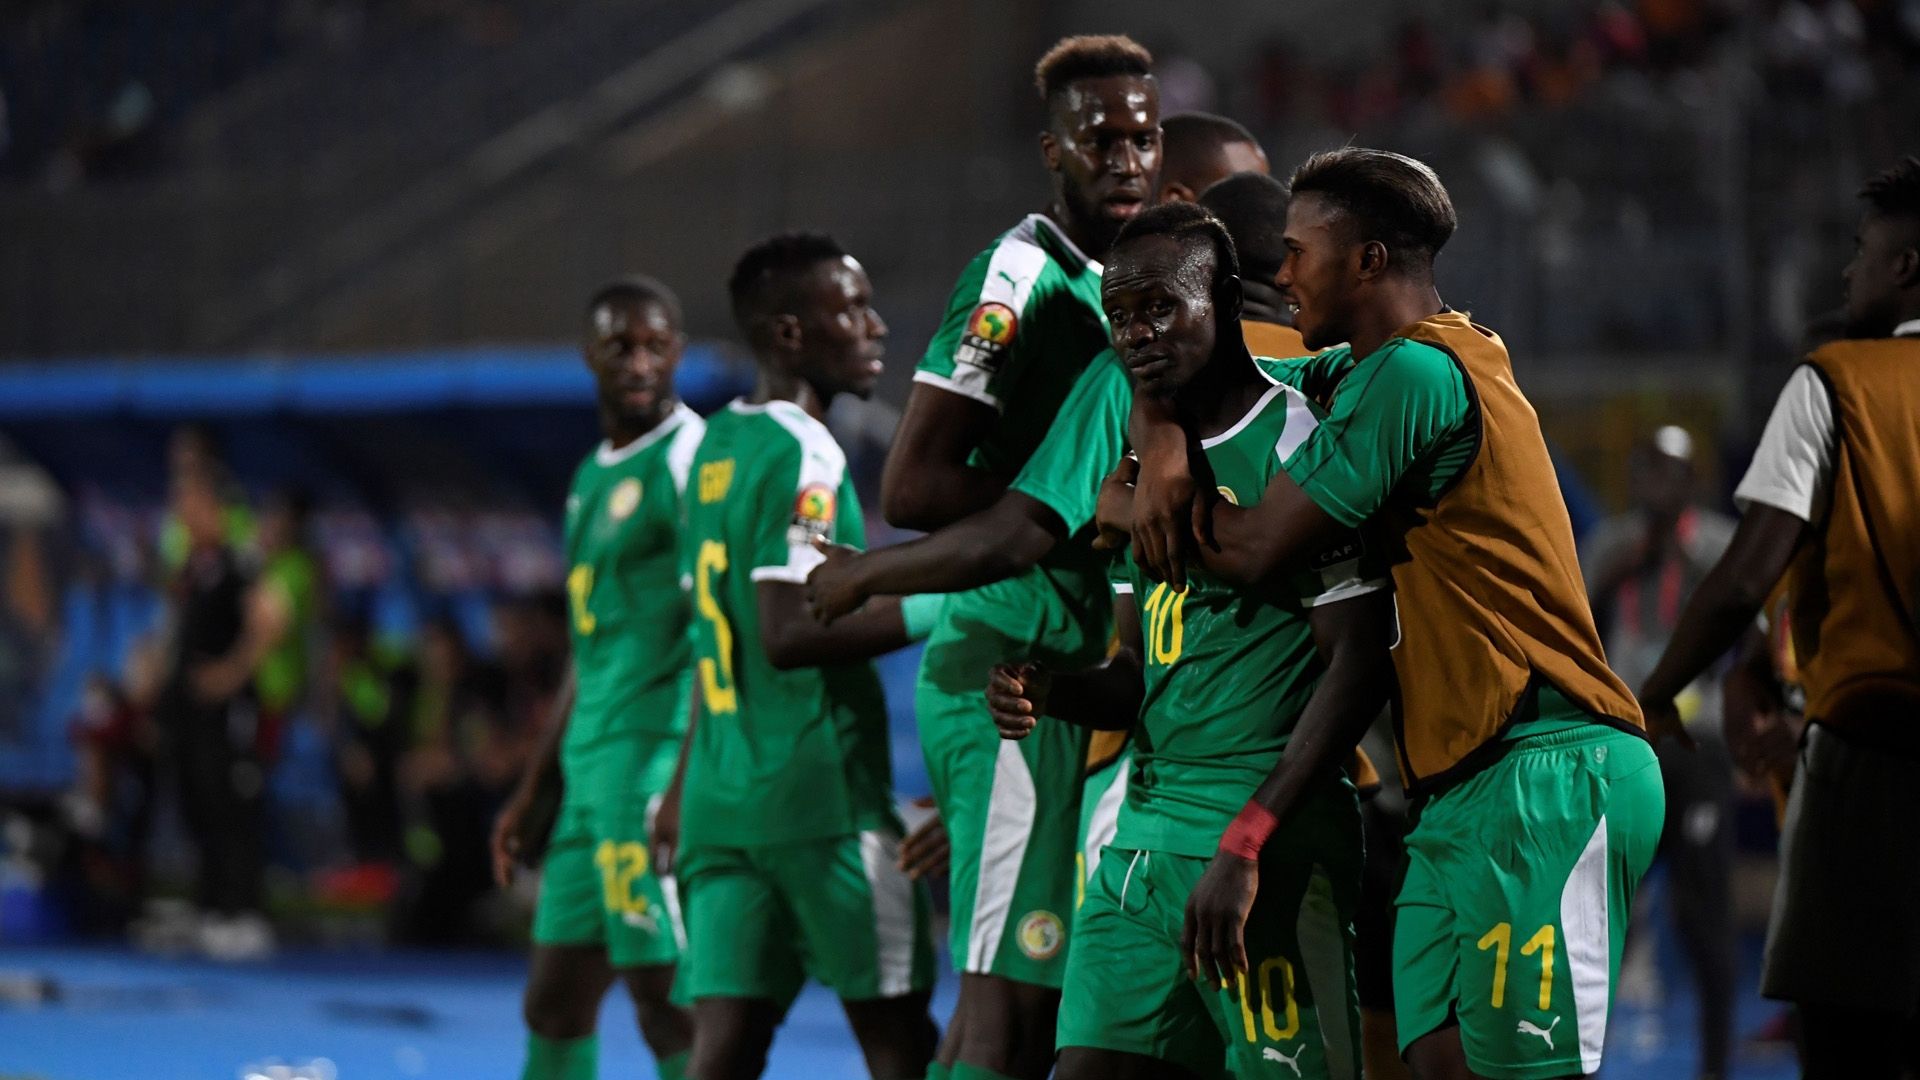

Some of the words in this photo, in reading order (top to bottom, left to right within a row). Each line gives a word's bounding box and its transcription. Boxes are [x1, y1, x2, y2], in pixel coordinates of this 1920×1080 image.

[1320, 544, 1353, 562] CAF
[697, 540, 737, 716] 5
[1144, 581, 1190, 665] 10
[594, 839, 648, 914] 12
[1221, 956, 1300, 1043] 10
[1477, 921, 1555, 1011] 11
